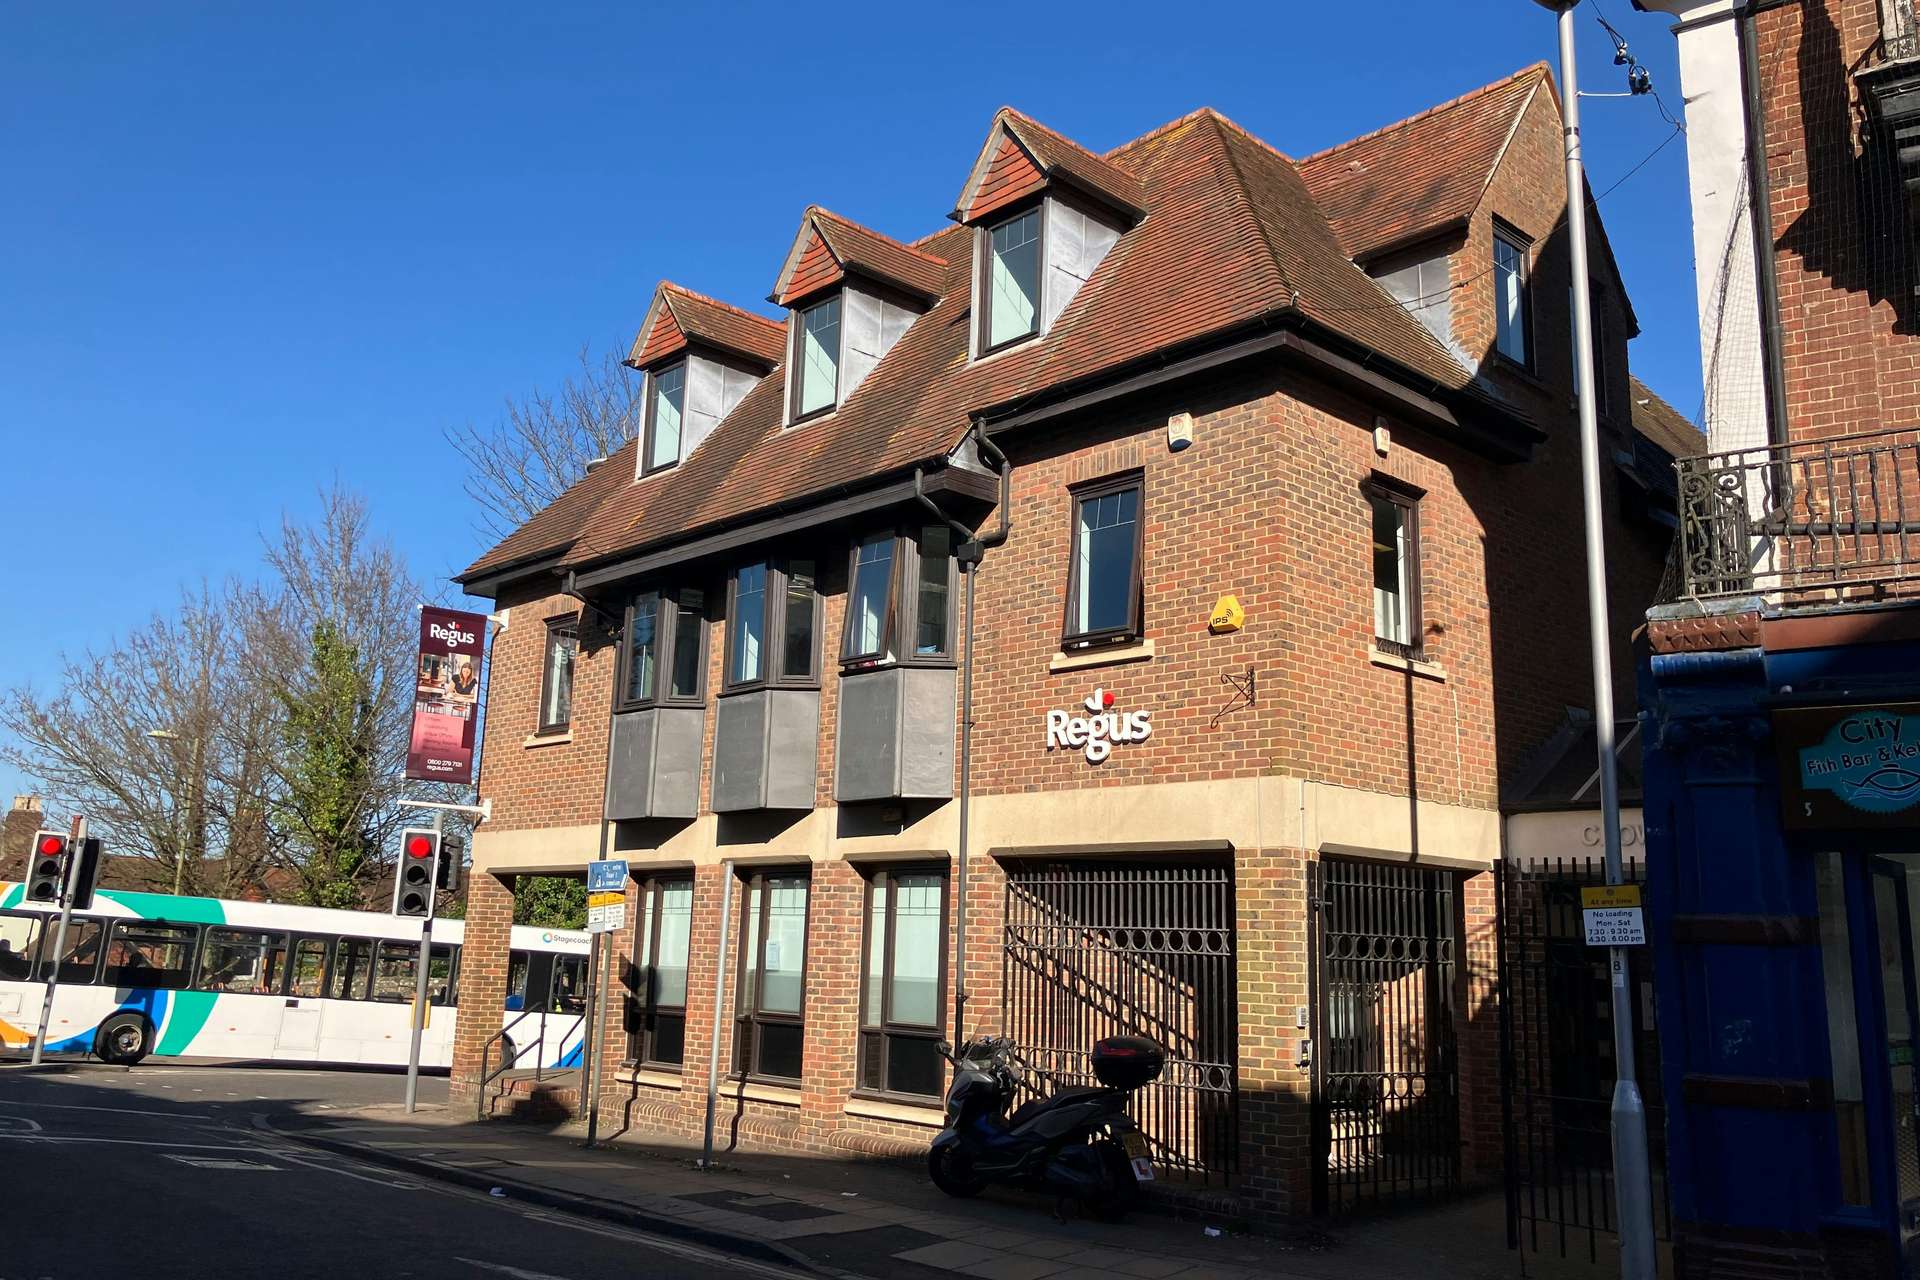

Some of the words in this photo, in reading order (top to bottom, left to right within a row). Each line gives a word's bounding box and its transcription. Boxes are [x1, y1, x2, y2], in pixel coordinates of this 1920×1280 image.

[430, 622, 475, 647] Regus
[1212, 616, 1228, 625] IPS
[1047, 703, 1152, 765] Regus
[1839, 716, 1903, 744] City
[1806, 758, 1839, 776] Fish
[1840, 752, 1872, 770] Bar
[1876, 745, 1892, 762] &
